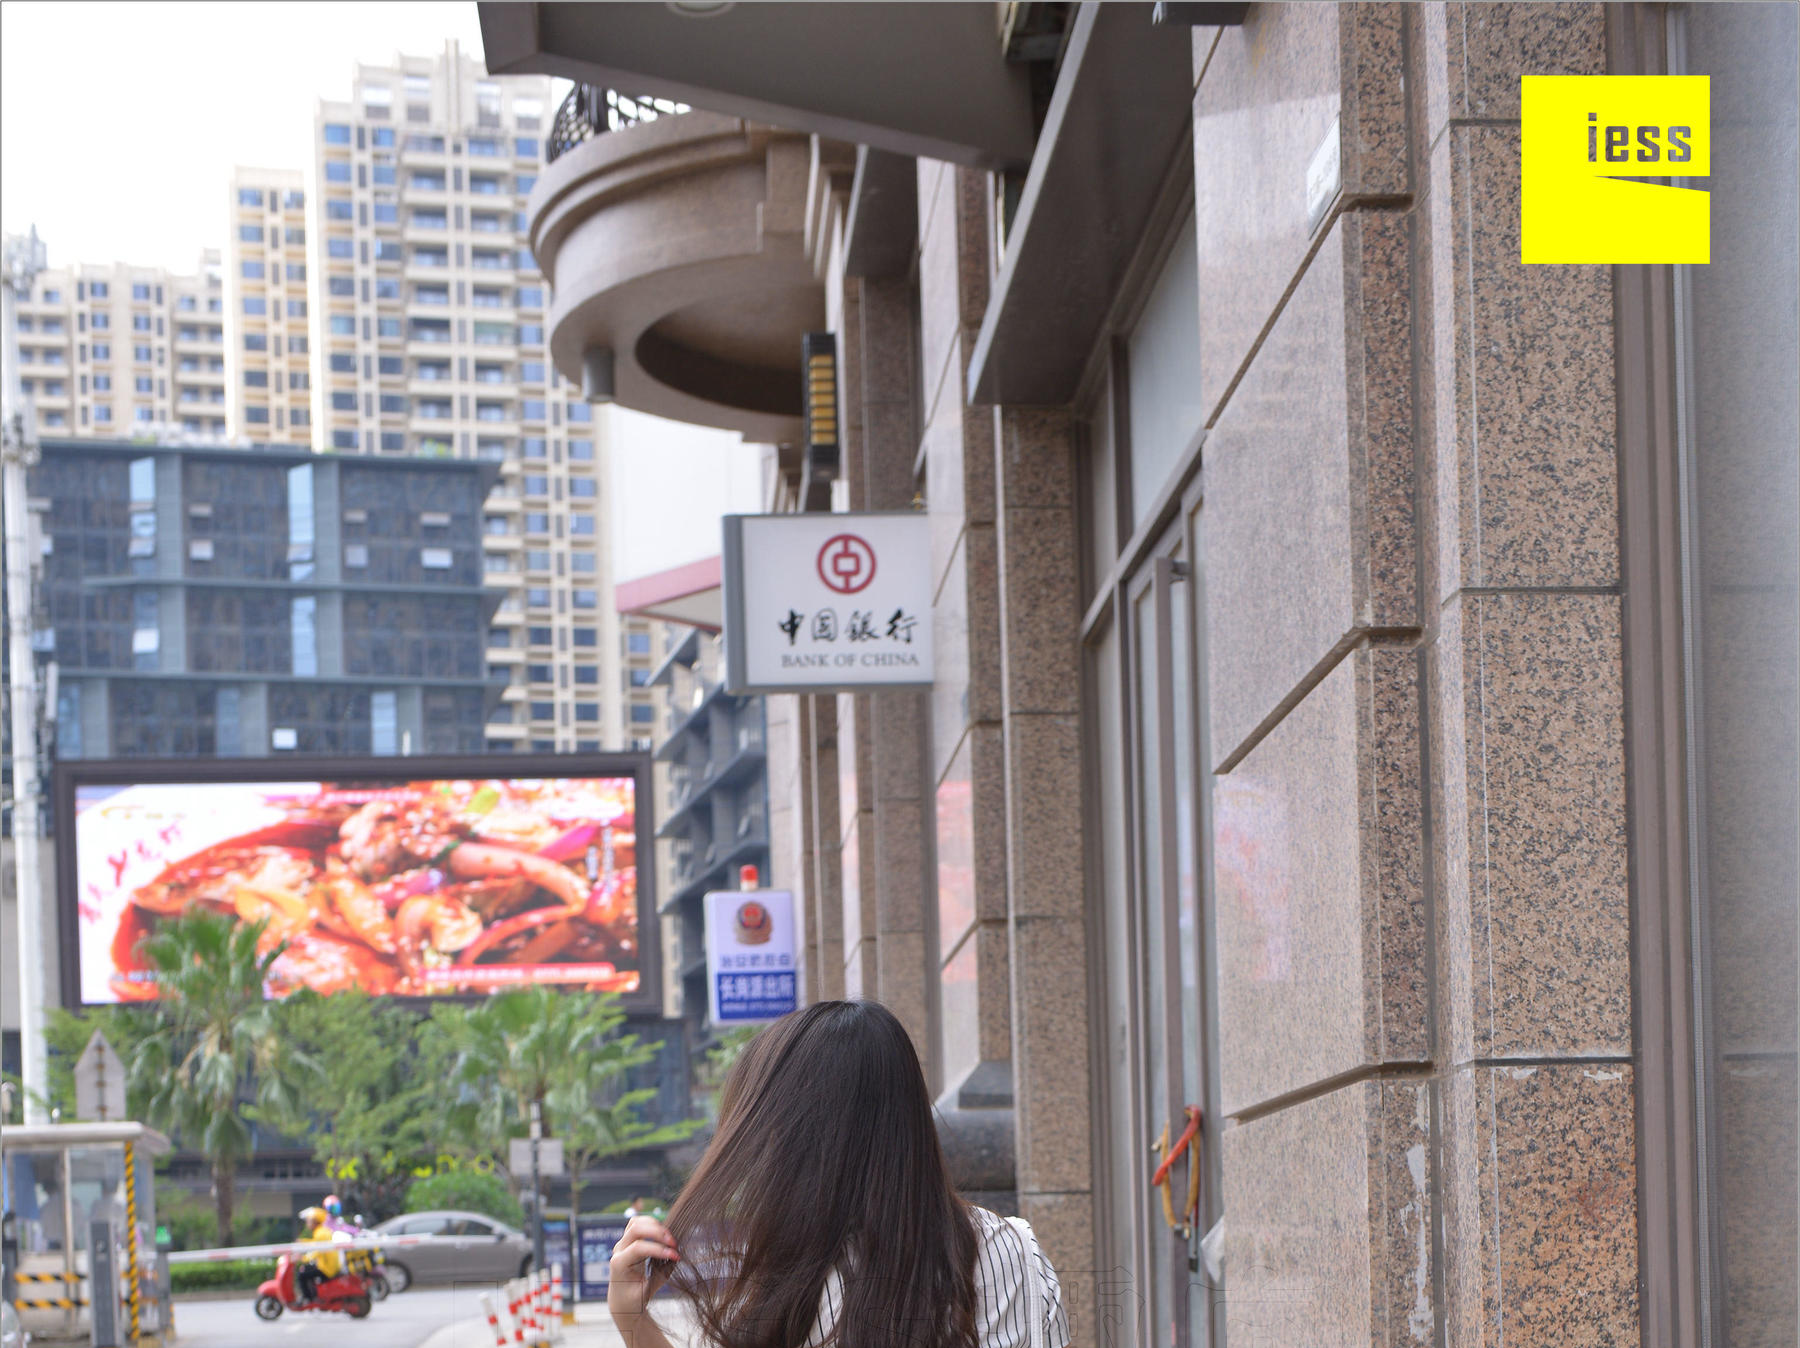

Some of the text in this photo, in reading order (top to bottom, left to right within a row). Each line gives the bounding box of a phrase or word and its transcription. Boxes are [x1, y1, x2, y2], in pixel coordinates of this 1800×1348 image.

[782, 653, 919, 668] BANK OF CHINA
